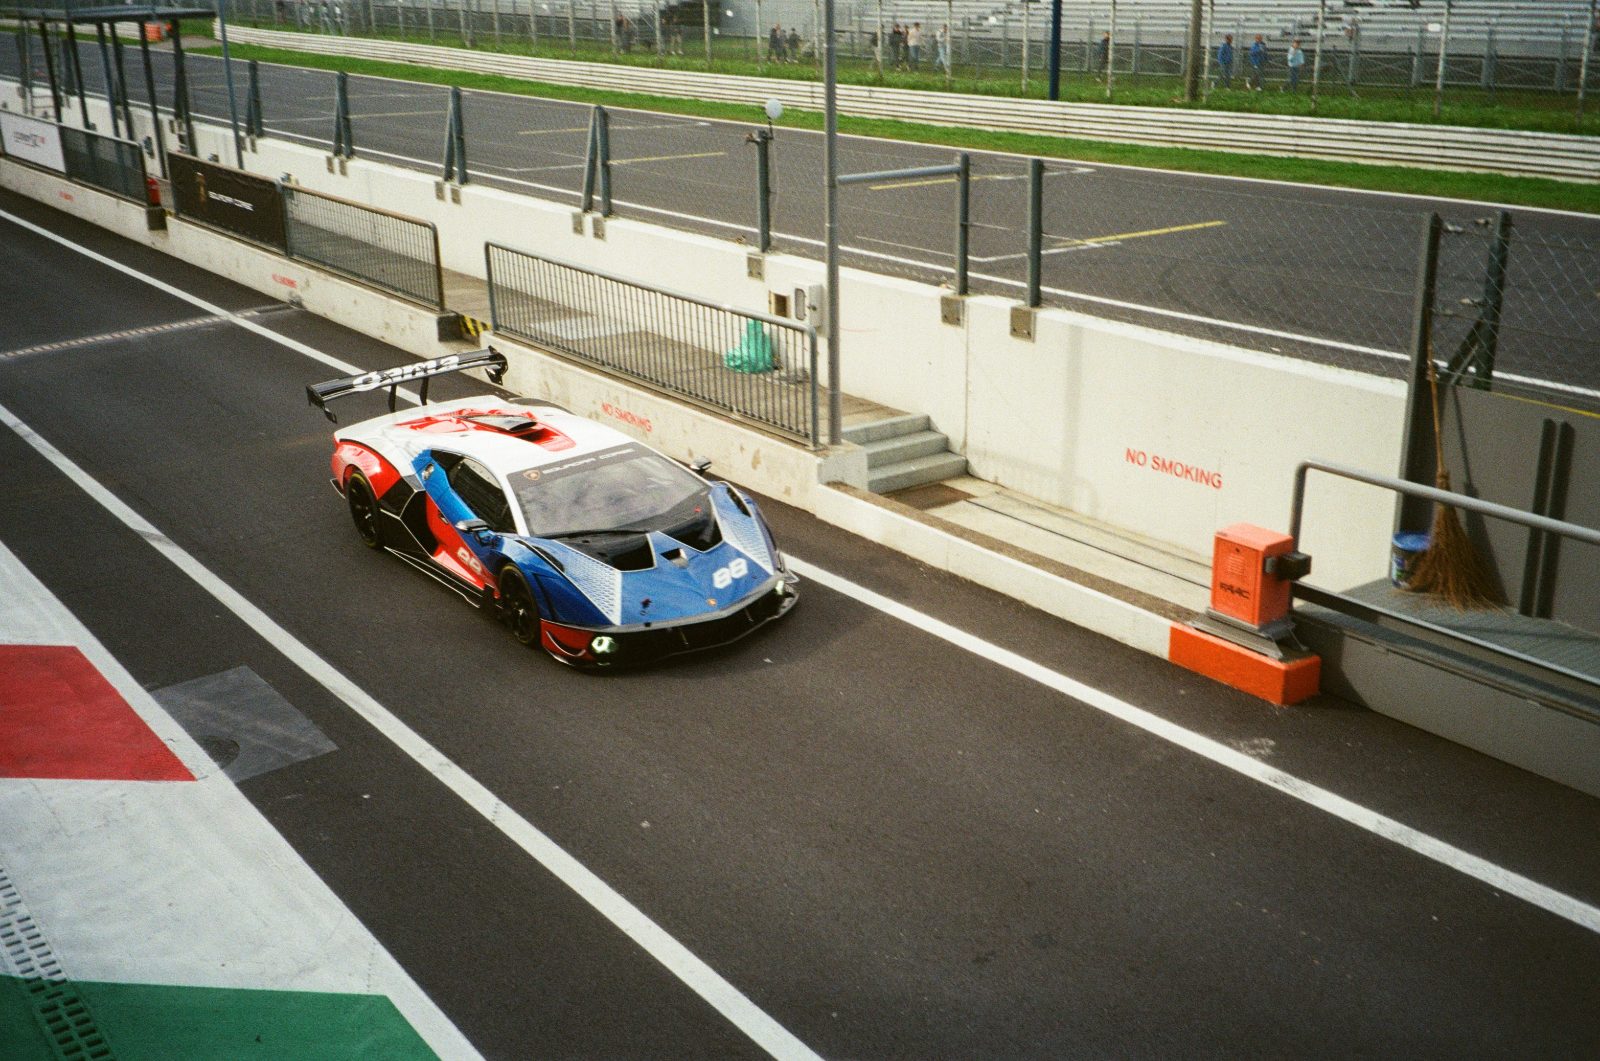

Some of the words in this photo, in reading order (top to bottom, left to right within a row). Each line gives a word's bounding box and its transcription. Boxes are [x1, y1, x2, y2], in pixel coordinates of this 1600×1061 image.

[601, 402, 613, 416] NO
[1126, 448, 1147, 466] NO
[1151, 455, 1222, 489] SMOKING
[712, 558, 748, 589] 88
